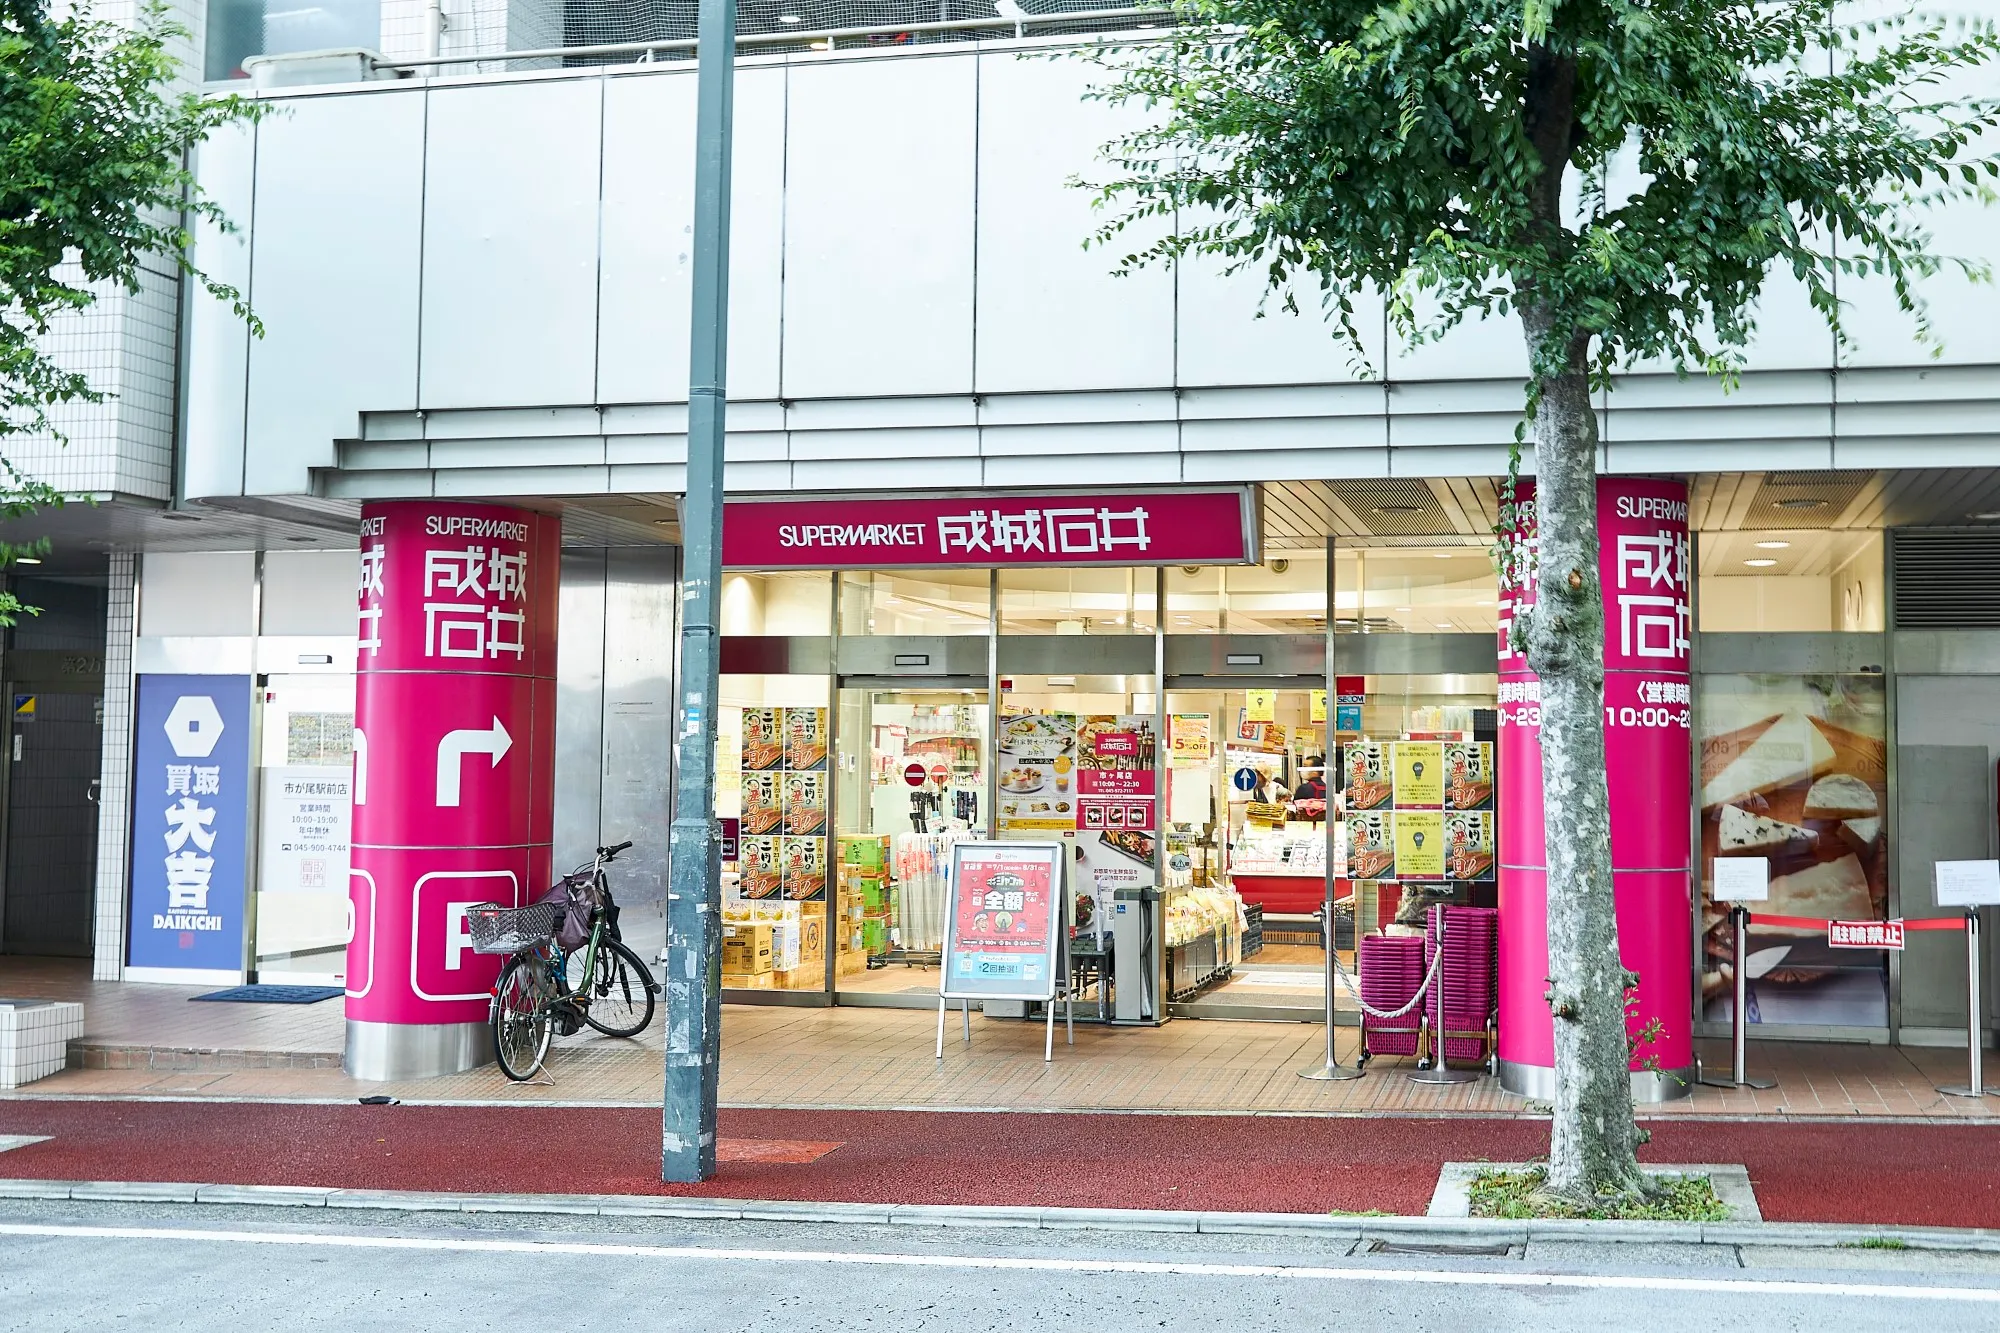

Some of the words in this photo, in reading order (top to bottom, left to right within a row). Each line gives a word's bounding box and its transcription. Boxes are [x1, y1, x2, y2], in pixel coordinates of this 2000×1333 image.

[425, 516, 529, 543] SUPERMARKET
[779, 523, 926, 547] SUPERMARKET
[936, 506, 1152, 554] 成城石井
[424, 545, 528, 603] 成城
[423, 602, 526, 661] 石井
[1338, 695, 1364, 703] SECOM
[165, 764, 221, 797] 買取
[284, 782, 348, 795] 市が尾駅前店
[299, 804, 331, 813] 営業時間
[299, 826, 330, 835] 年中無休
[164, 796, 217, 909] 大吉
[294, 843, 346, 852] 045-900-4744
[984, 890, 1023, 911] 全額
[153, 914, 222, 931] DAIKICHI
[1832, 925, 1902, 944] 駐輪禁止
